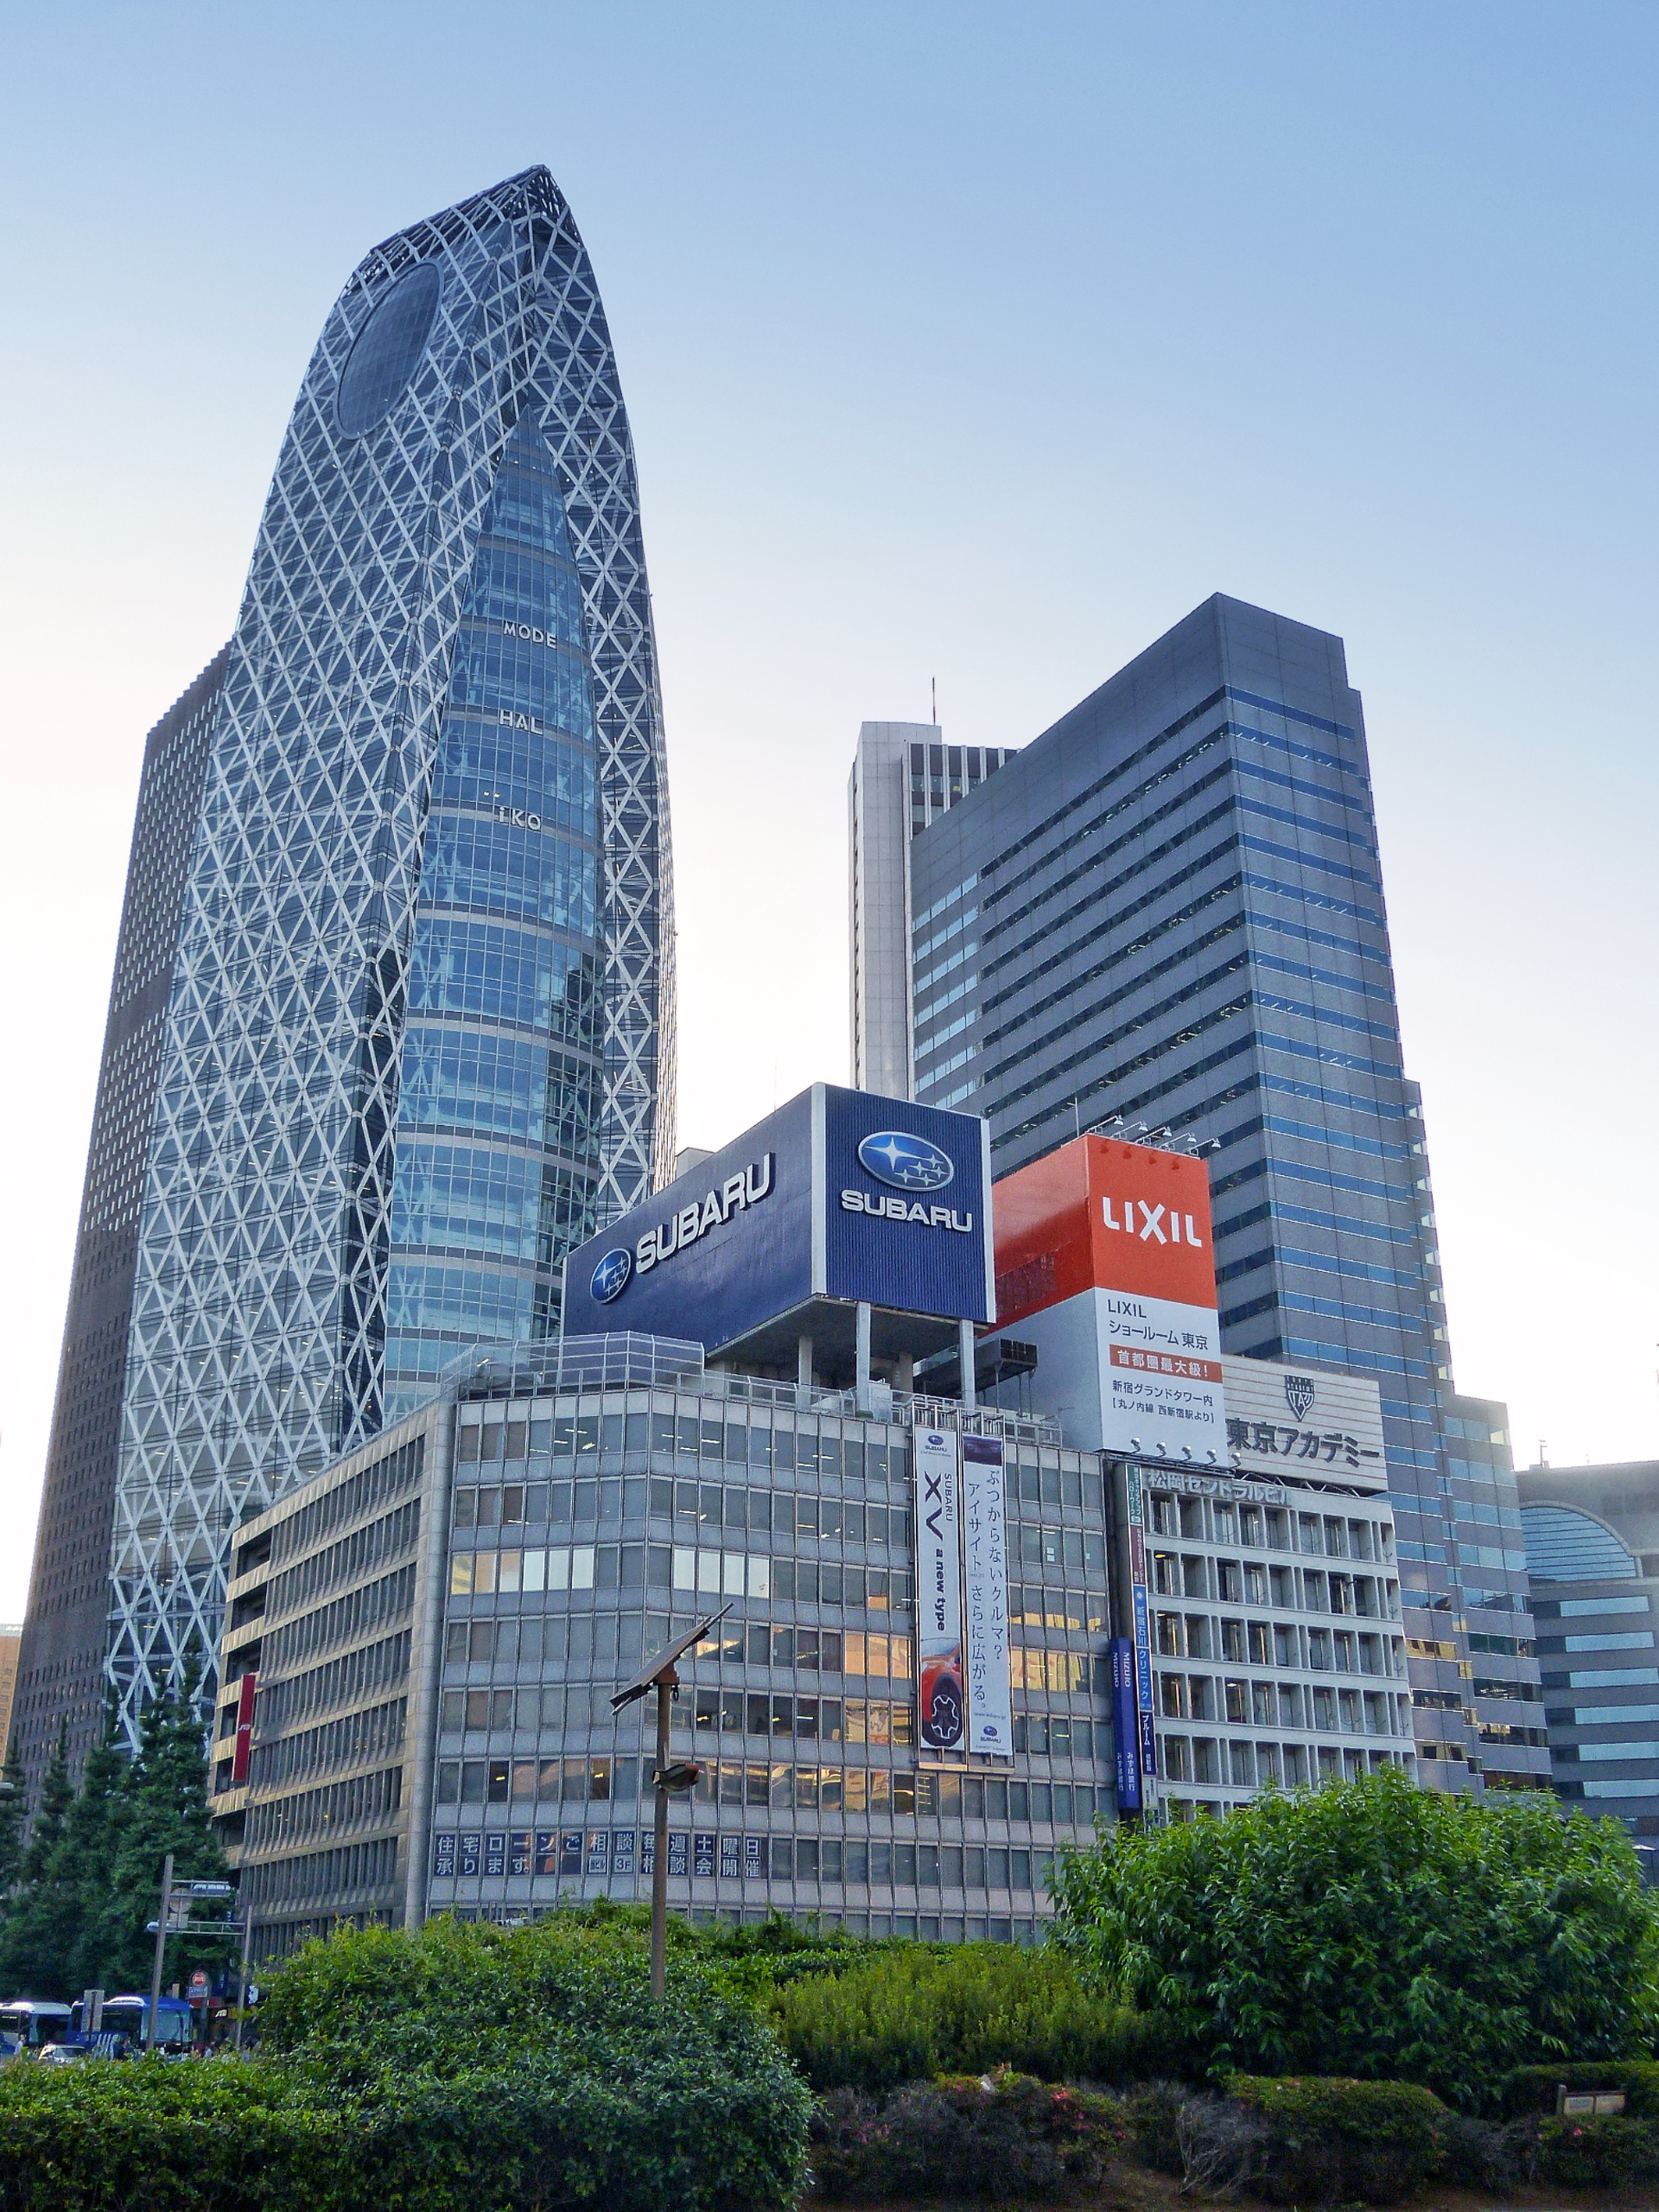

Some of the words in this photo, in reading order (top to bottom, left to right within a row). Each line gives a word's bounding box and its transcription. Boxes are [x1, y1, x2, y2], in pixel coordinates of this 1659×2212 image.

[503, 620, 557, 649] MODE
[499, 709, 544, 736] HAL
[635, 1152, 772, 1275] SUBARU
[840, 1188, 974, 1234] SUBARU
[1102, 1196, 1203, 1248] LIXIL
[1108, 1298, 1147, 1319] LIXIL
[1109, 1319, 1209, 1351] ショールーム東京
[1112, 1379, 1213, 1407] 新宿グランドタワー内
[1227, 1418, 1380, 1468] 東京アカデミー
[944, 1472, 954, 1521] SUBARU
[1148, 1470, 1290, 1504] 松岡セントラルビル
[924, 1470, 943, 1542] XV
[968, 1482, 982, 1571] アイサイト
[936, 1548, 943, 1558] a
[986, 1469, 1004, 1660] ぶつからないクルマ？
[936, 1560, 944, 1594] new
[934, 1596, 946, 1631] type
[971, 1585, 986, 1709] さらに広がる。
[1137, 1606, 1152, 1700] 新宿石川クリニック
[1123, 1651, 1131, 1688] MIZUHO
[438, 1833, 633, 1854] 住宅ローンご相談
[436, 1857, 530, 1875] 承ります。
[616, 1859, 631, 1870] 3F
